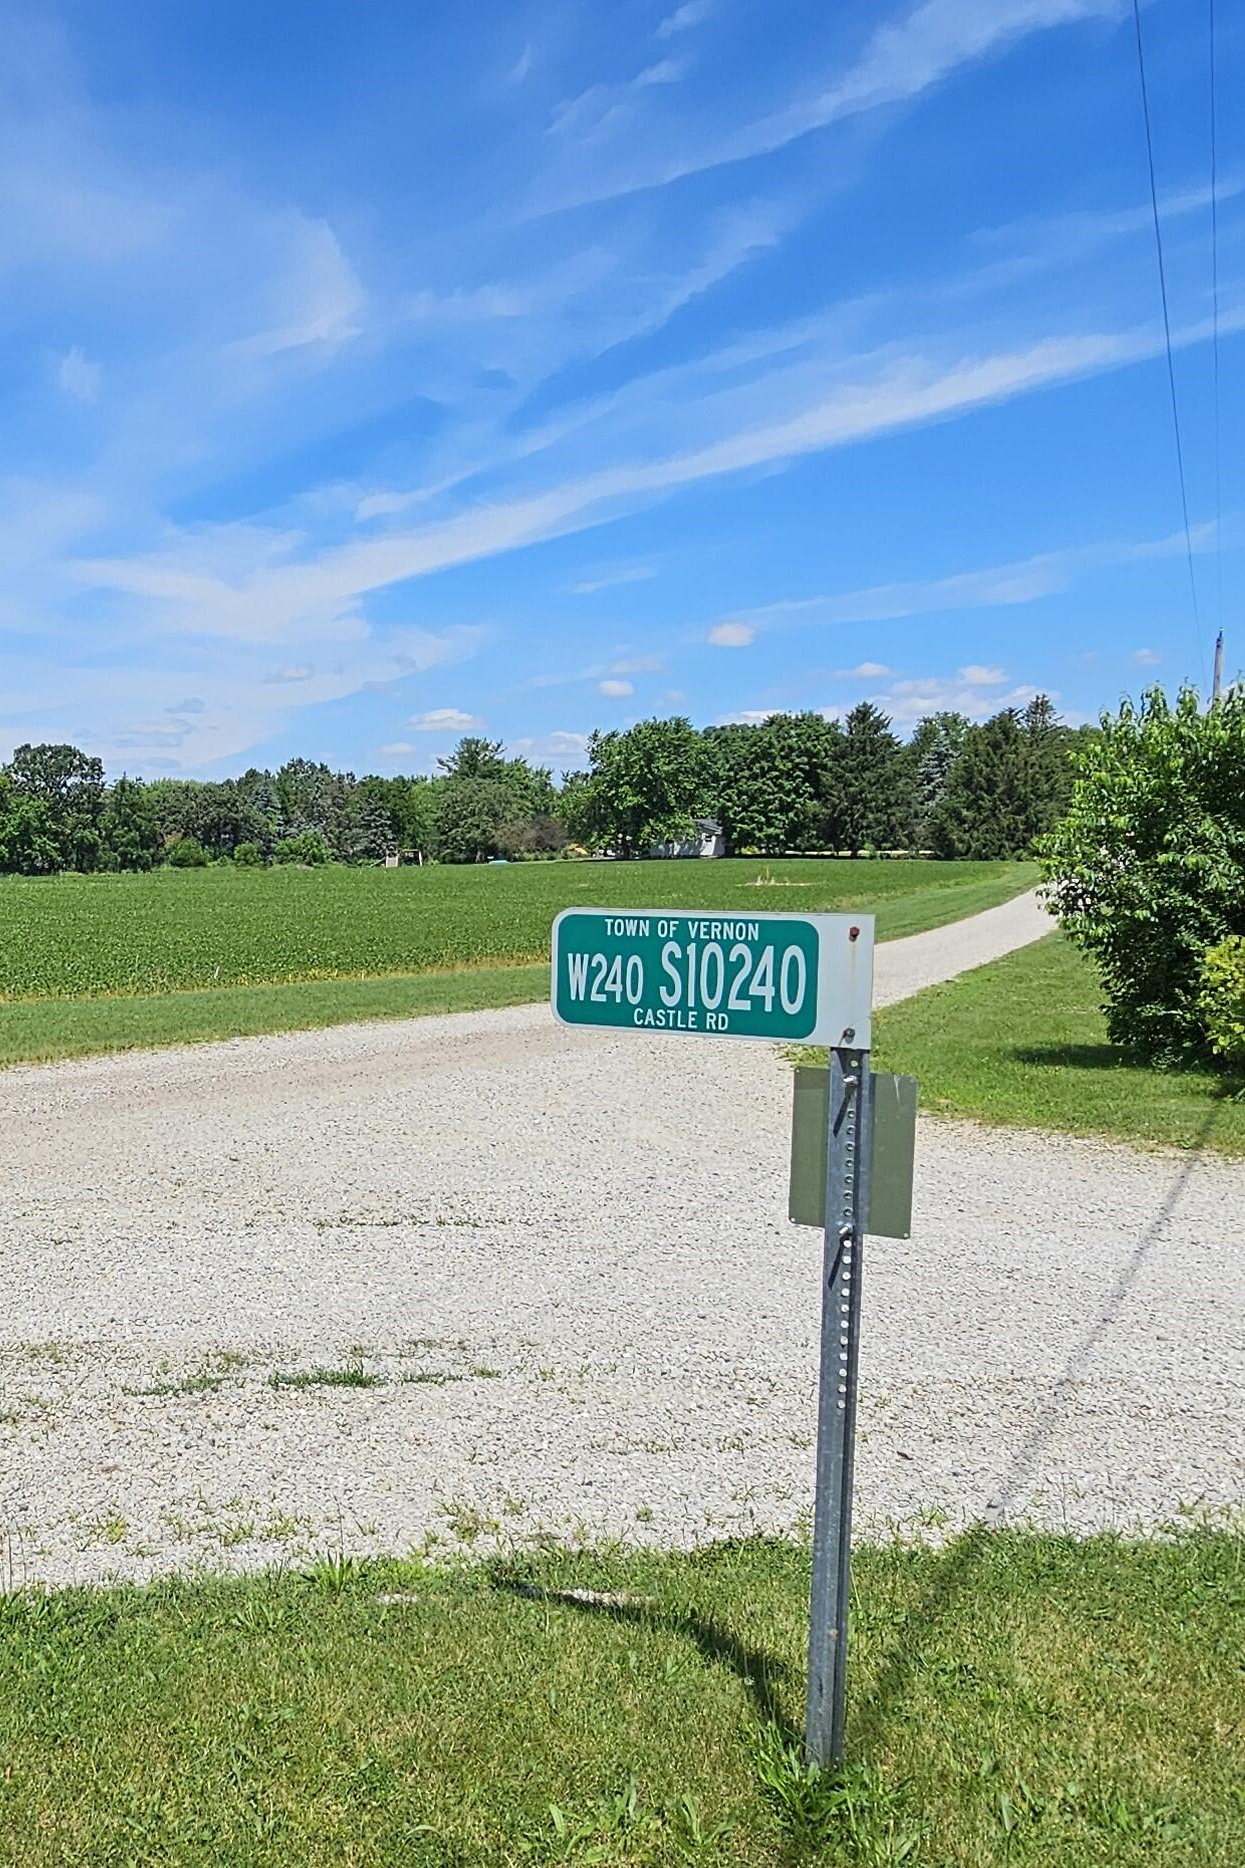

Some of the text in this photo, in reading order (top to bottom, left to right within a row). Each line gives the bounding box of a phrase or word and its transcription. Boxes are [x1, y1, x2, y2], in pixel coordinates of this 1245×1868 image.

[605, 918, 759, 941] TOWN OF VERNON
[568, 941, 806, 1015] W240 S10240
[634, 1008, 729, 1030] CASTLE RD
